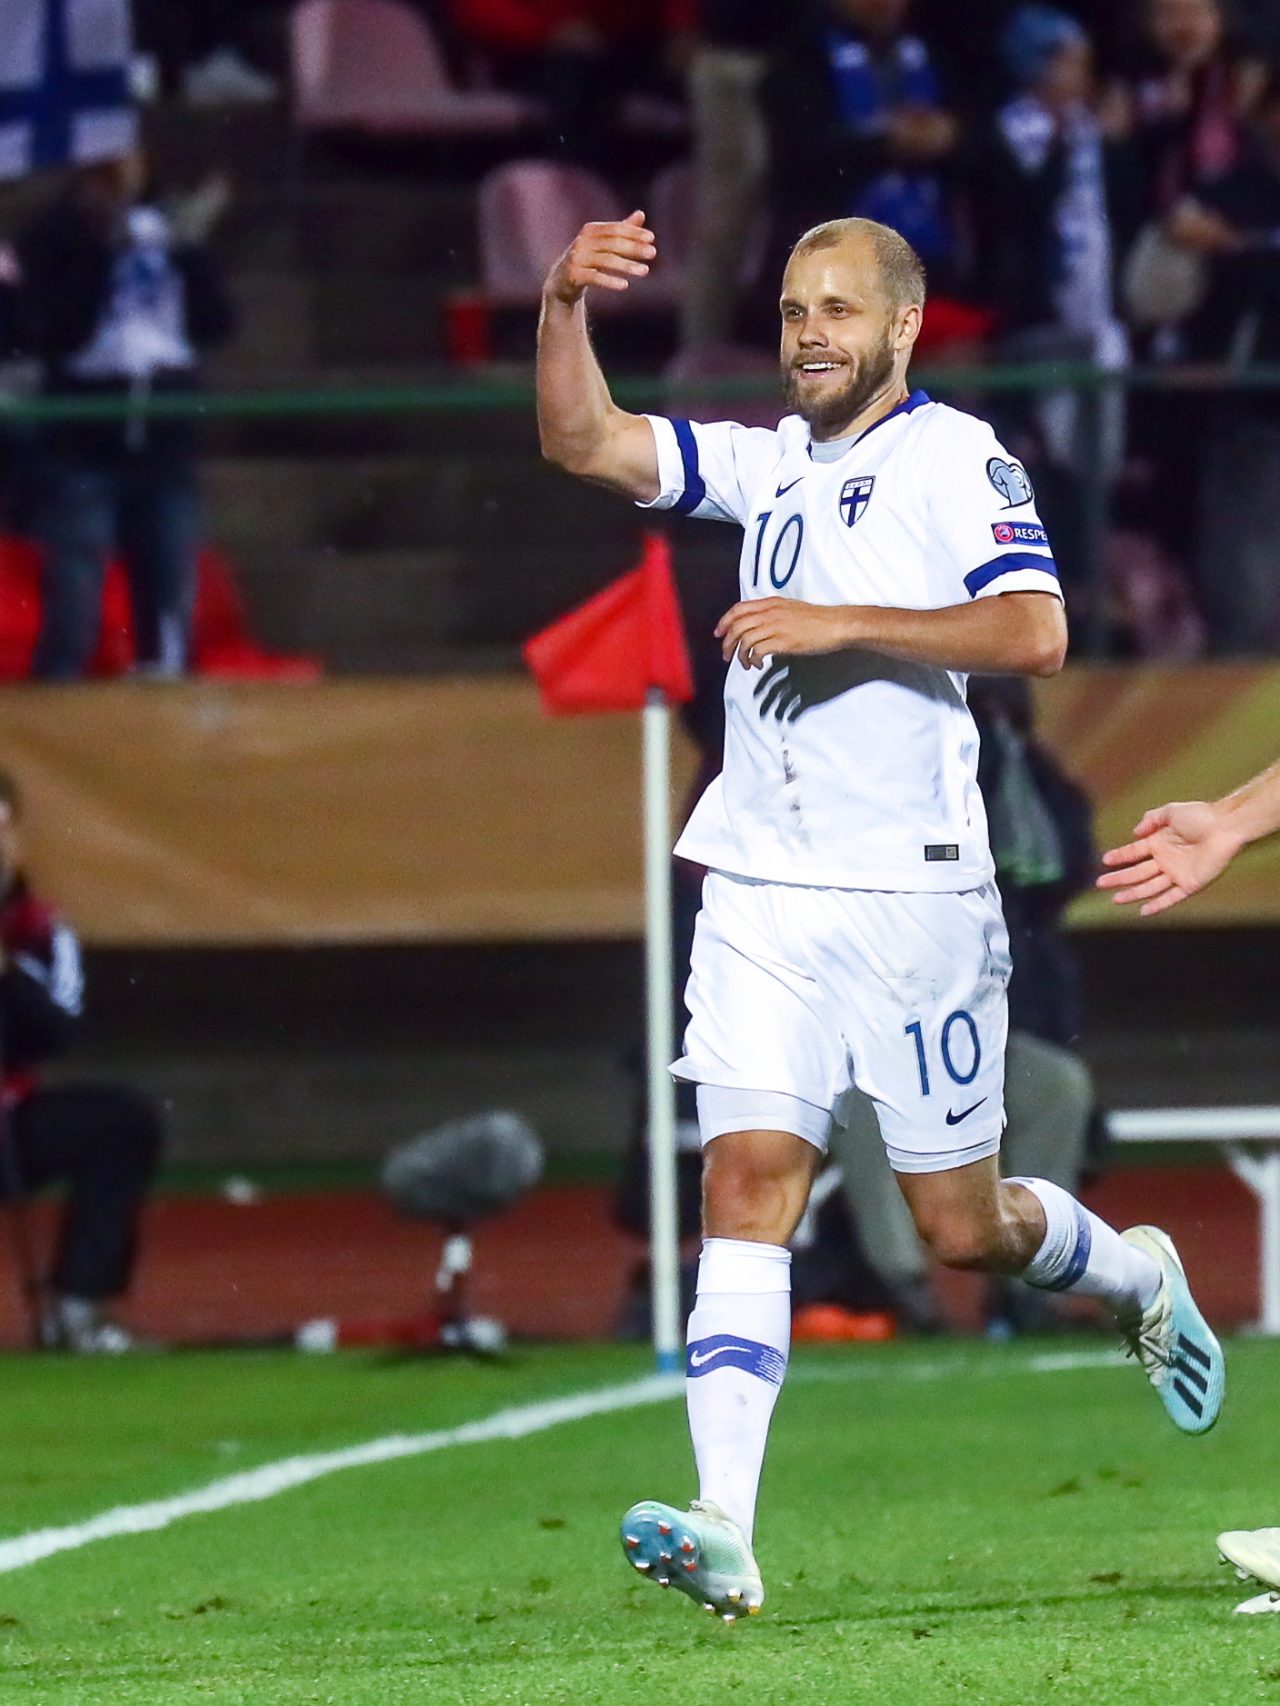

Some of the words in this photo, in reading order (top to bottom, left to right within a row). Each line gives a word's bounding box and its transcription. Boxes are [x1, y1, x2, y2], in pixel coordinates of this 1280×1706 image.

[753, 511, 804, 589] 10
[1014, 527, 1048, 541] RESPE
[904, 1010, 981, 1096] 10
